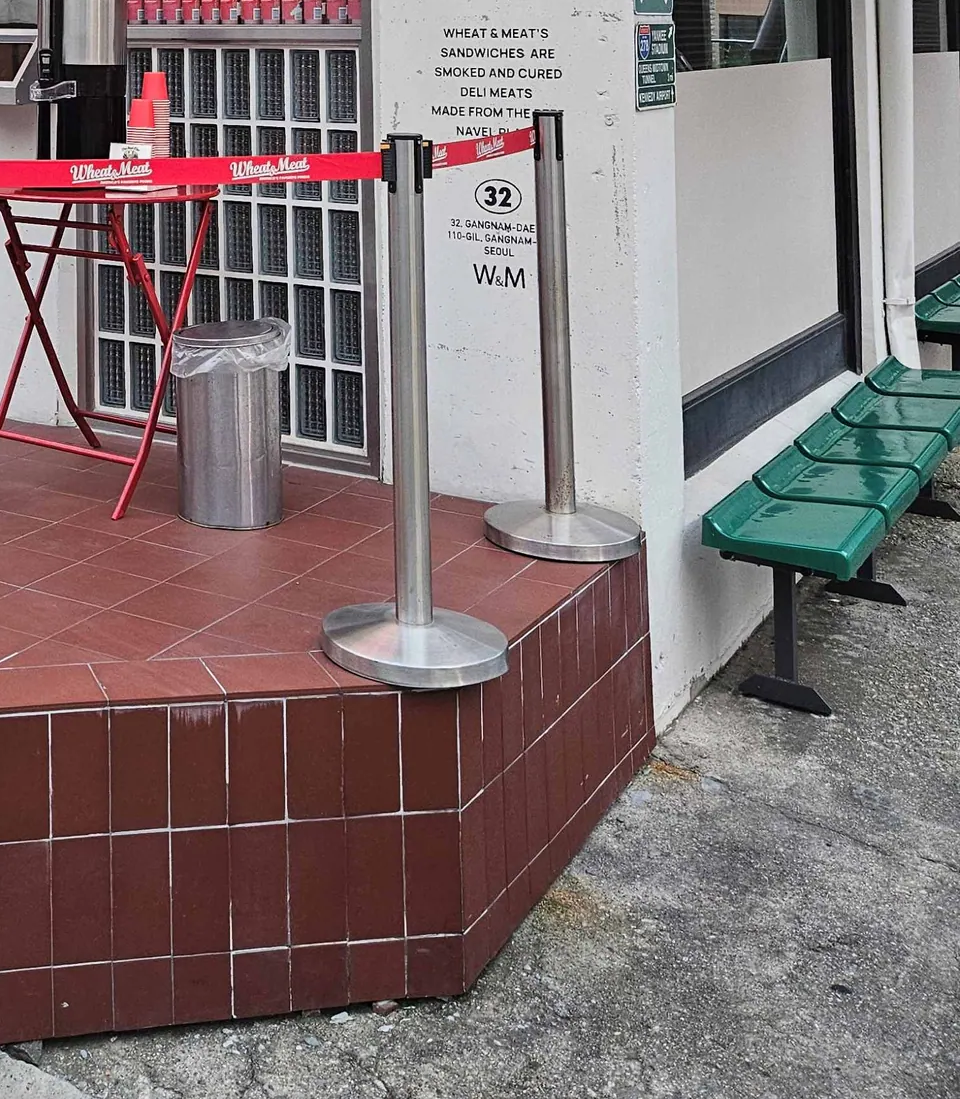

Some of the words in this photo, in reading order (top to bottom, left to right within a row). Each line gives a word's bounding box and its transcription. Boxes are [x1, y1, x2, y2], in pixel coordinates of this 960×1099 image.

[443, 28, 487, 38] WHEAT
[490, 29, 499, 39] &
[501, 28, 549, 39] MEAT'S
[440, 48, 525, 59] SANDWICHES
[530, 48, 555, 59] ARE
[434, 67, 485, 78] SMOKED
[489, 68, 515, 78] AND
[518, 68, 562, 79] CURED
[460, 87, 486, 97] DELI
[490, 88, 533, 99] MEATS
[431, 106, 465, 116] MADE
[468, 107, 503, 117] FROM
[506, 108, 530, 118] THE
[456, 126, 493, 137] NAVEL
[484, 186, 512, 207] 32
[465, 219, 536, 233] GANGNAM-DAE
[485, 233, 537, 245] GANGNAM-
[484, 246, 514, 257] SEOUL
[473, 263, 526, 289] W&M
